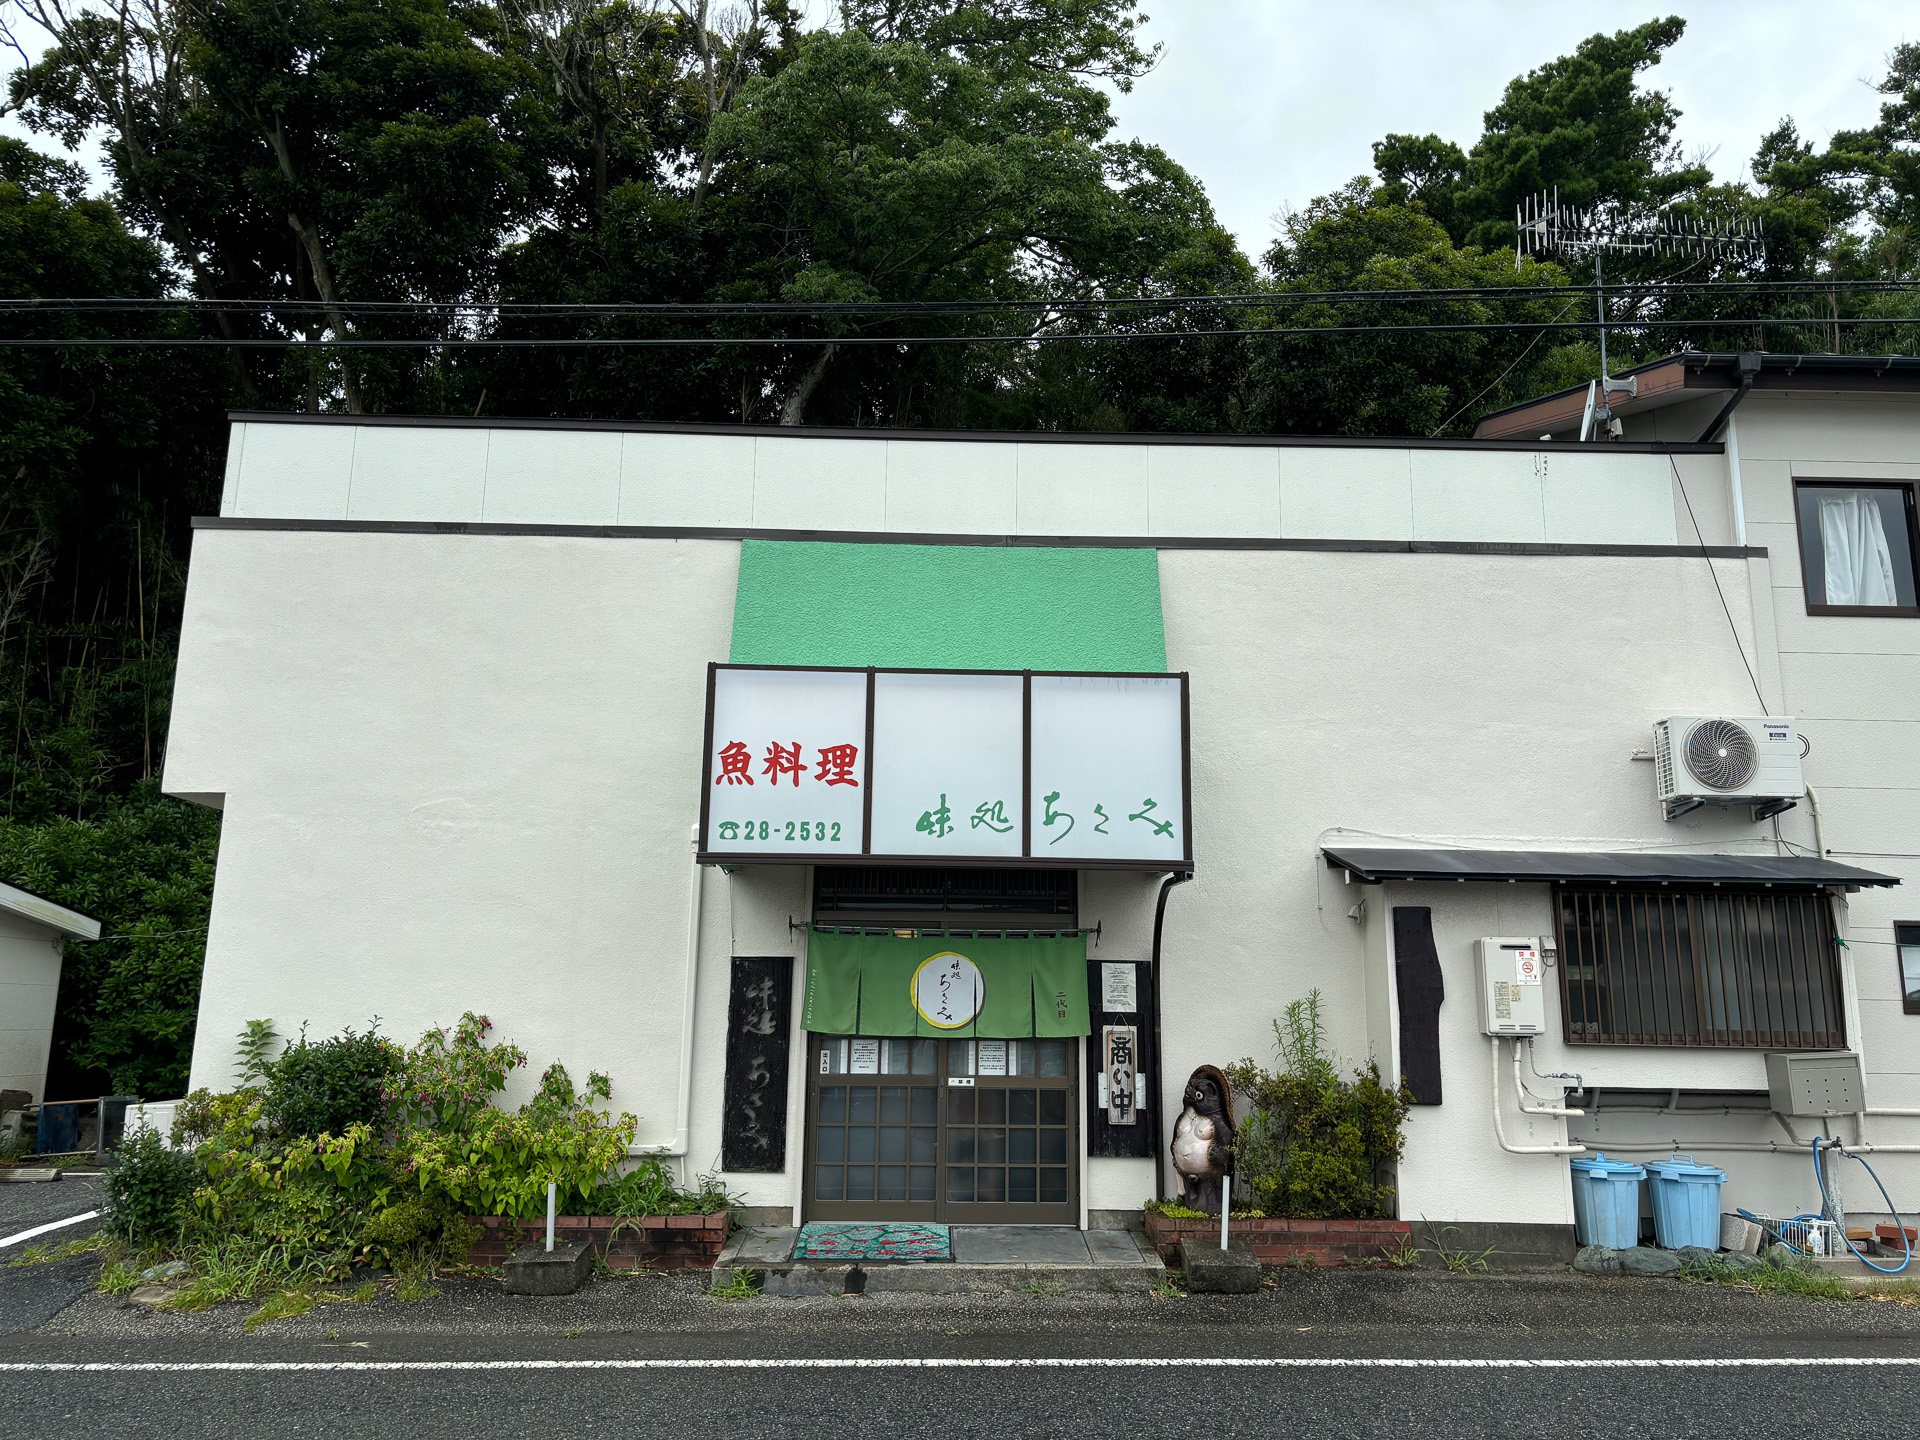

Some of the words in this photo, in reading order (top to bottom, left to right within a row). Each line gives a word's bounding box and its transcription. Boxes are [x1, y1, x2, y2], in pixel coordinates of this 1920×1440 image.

[715, 741, 859, 788] 魚料理
[743, 820, 842, 842] 28-2532
[915, 793, 1014, 839] 味処
[950, 959, 962, 980] 味処
[1055, 991, 1068, 1019] 二代目
[1110, 1036, 1134, 1121] 商い中
